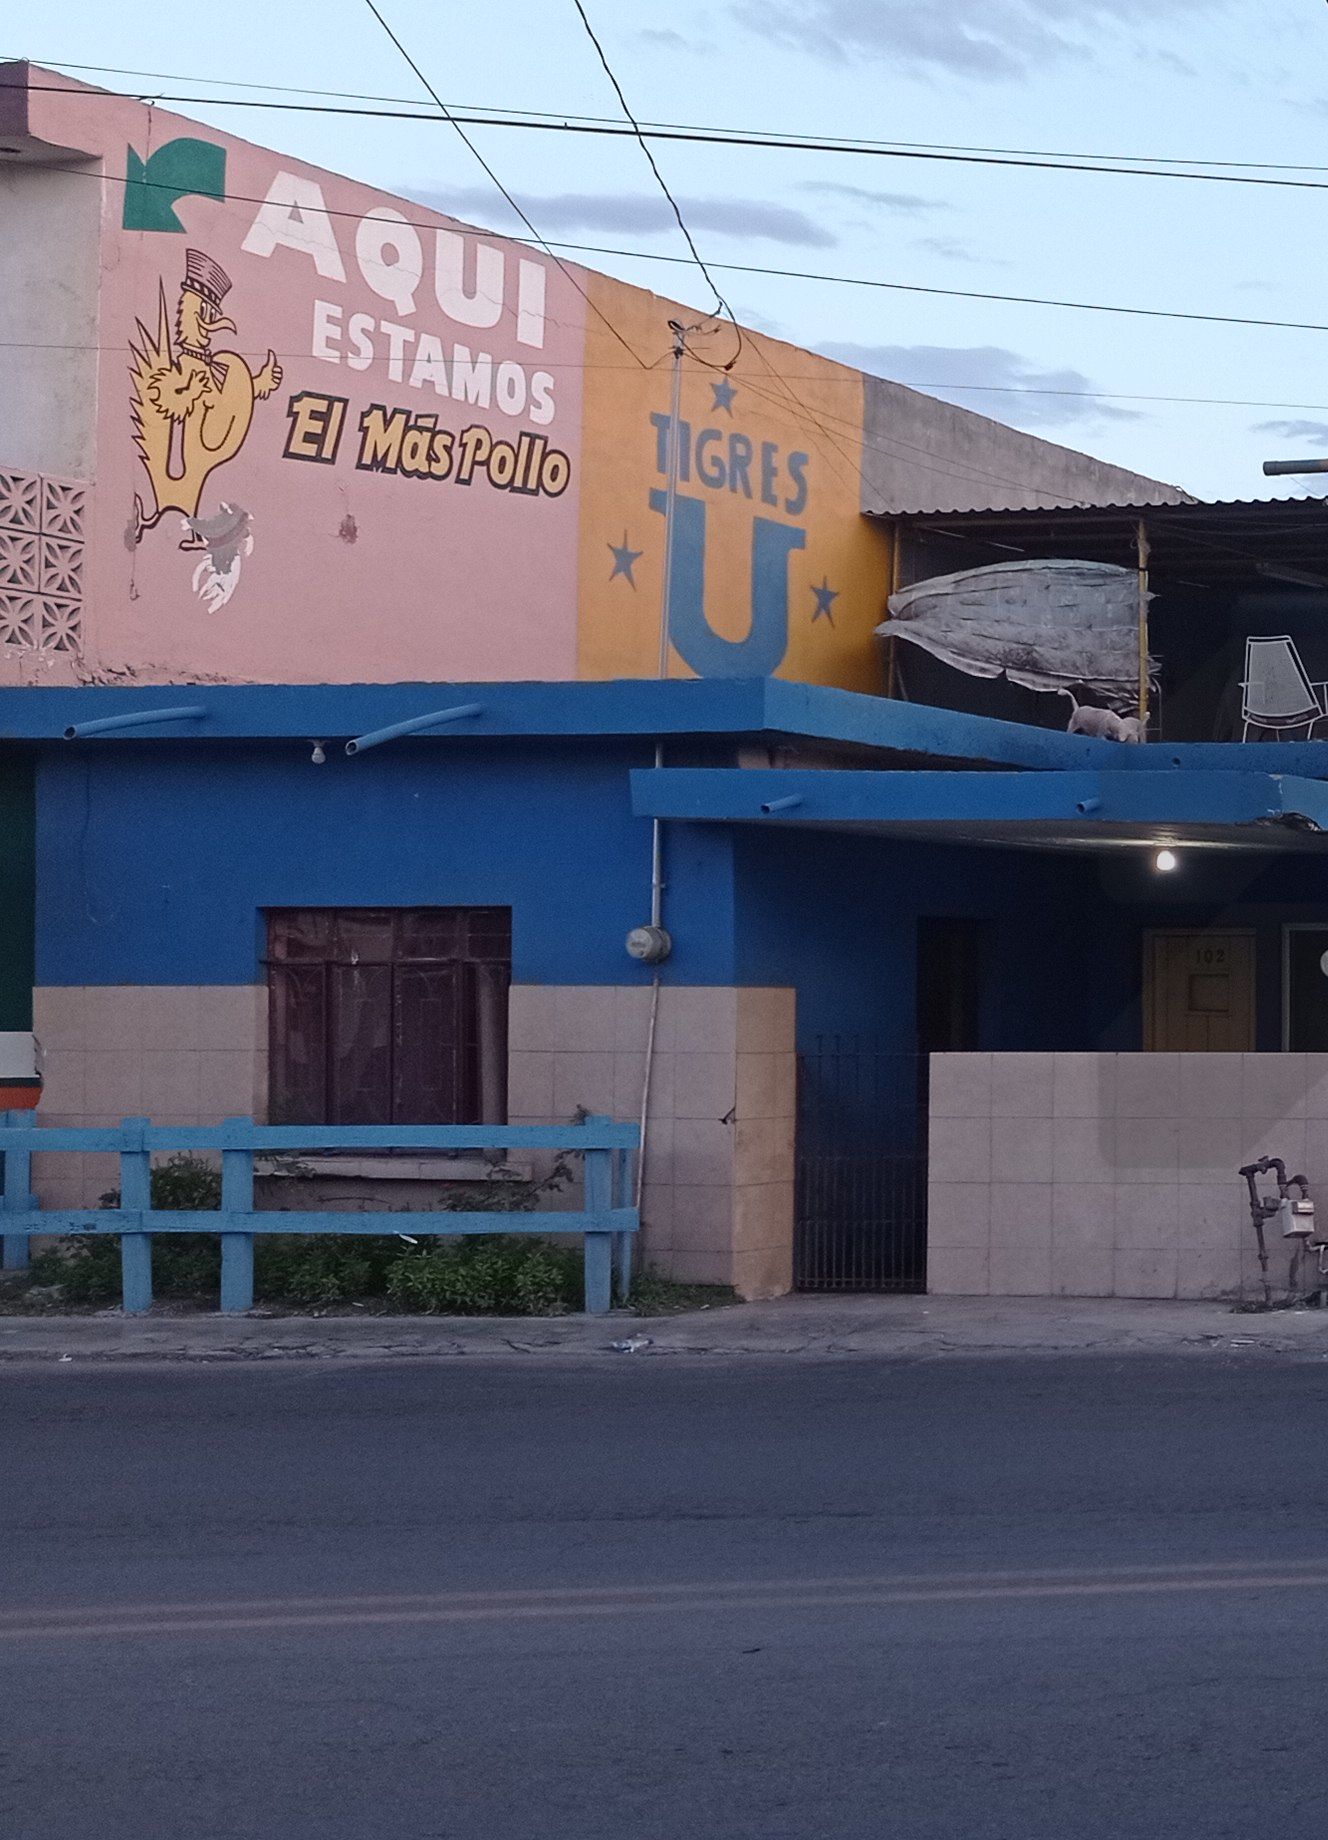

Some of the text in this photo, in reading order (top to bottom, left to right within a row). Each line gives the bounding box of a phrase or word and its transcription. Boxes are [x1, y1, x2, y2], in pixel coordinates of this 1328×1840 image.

[241, 168, 548, 349] AQUI
[312, 300, 556, 426] ESTAMOS
[282, 390, 349, 465] El
[650, 411, 809, 516] TIGRES
[649, 488, 806, 680] U
